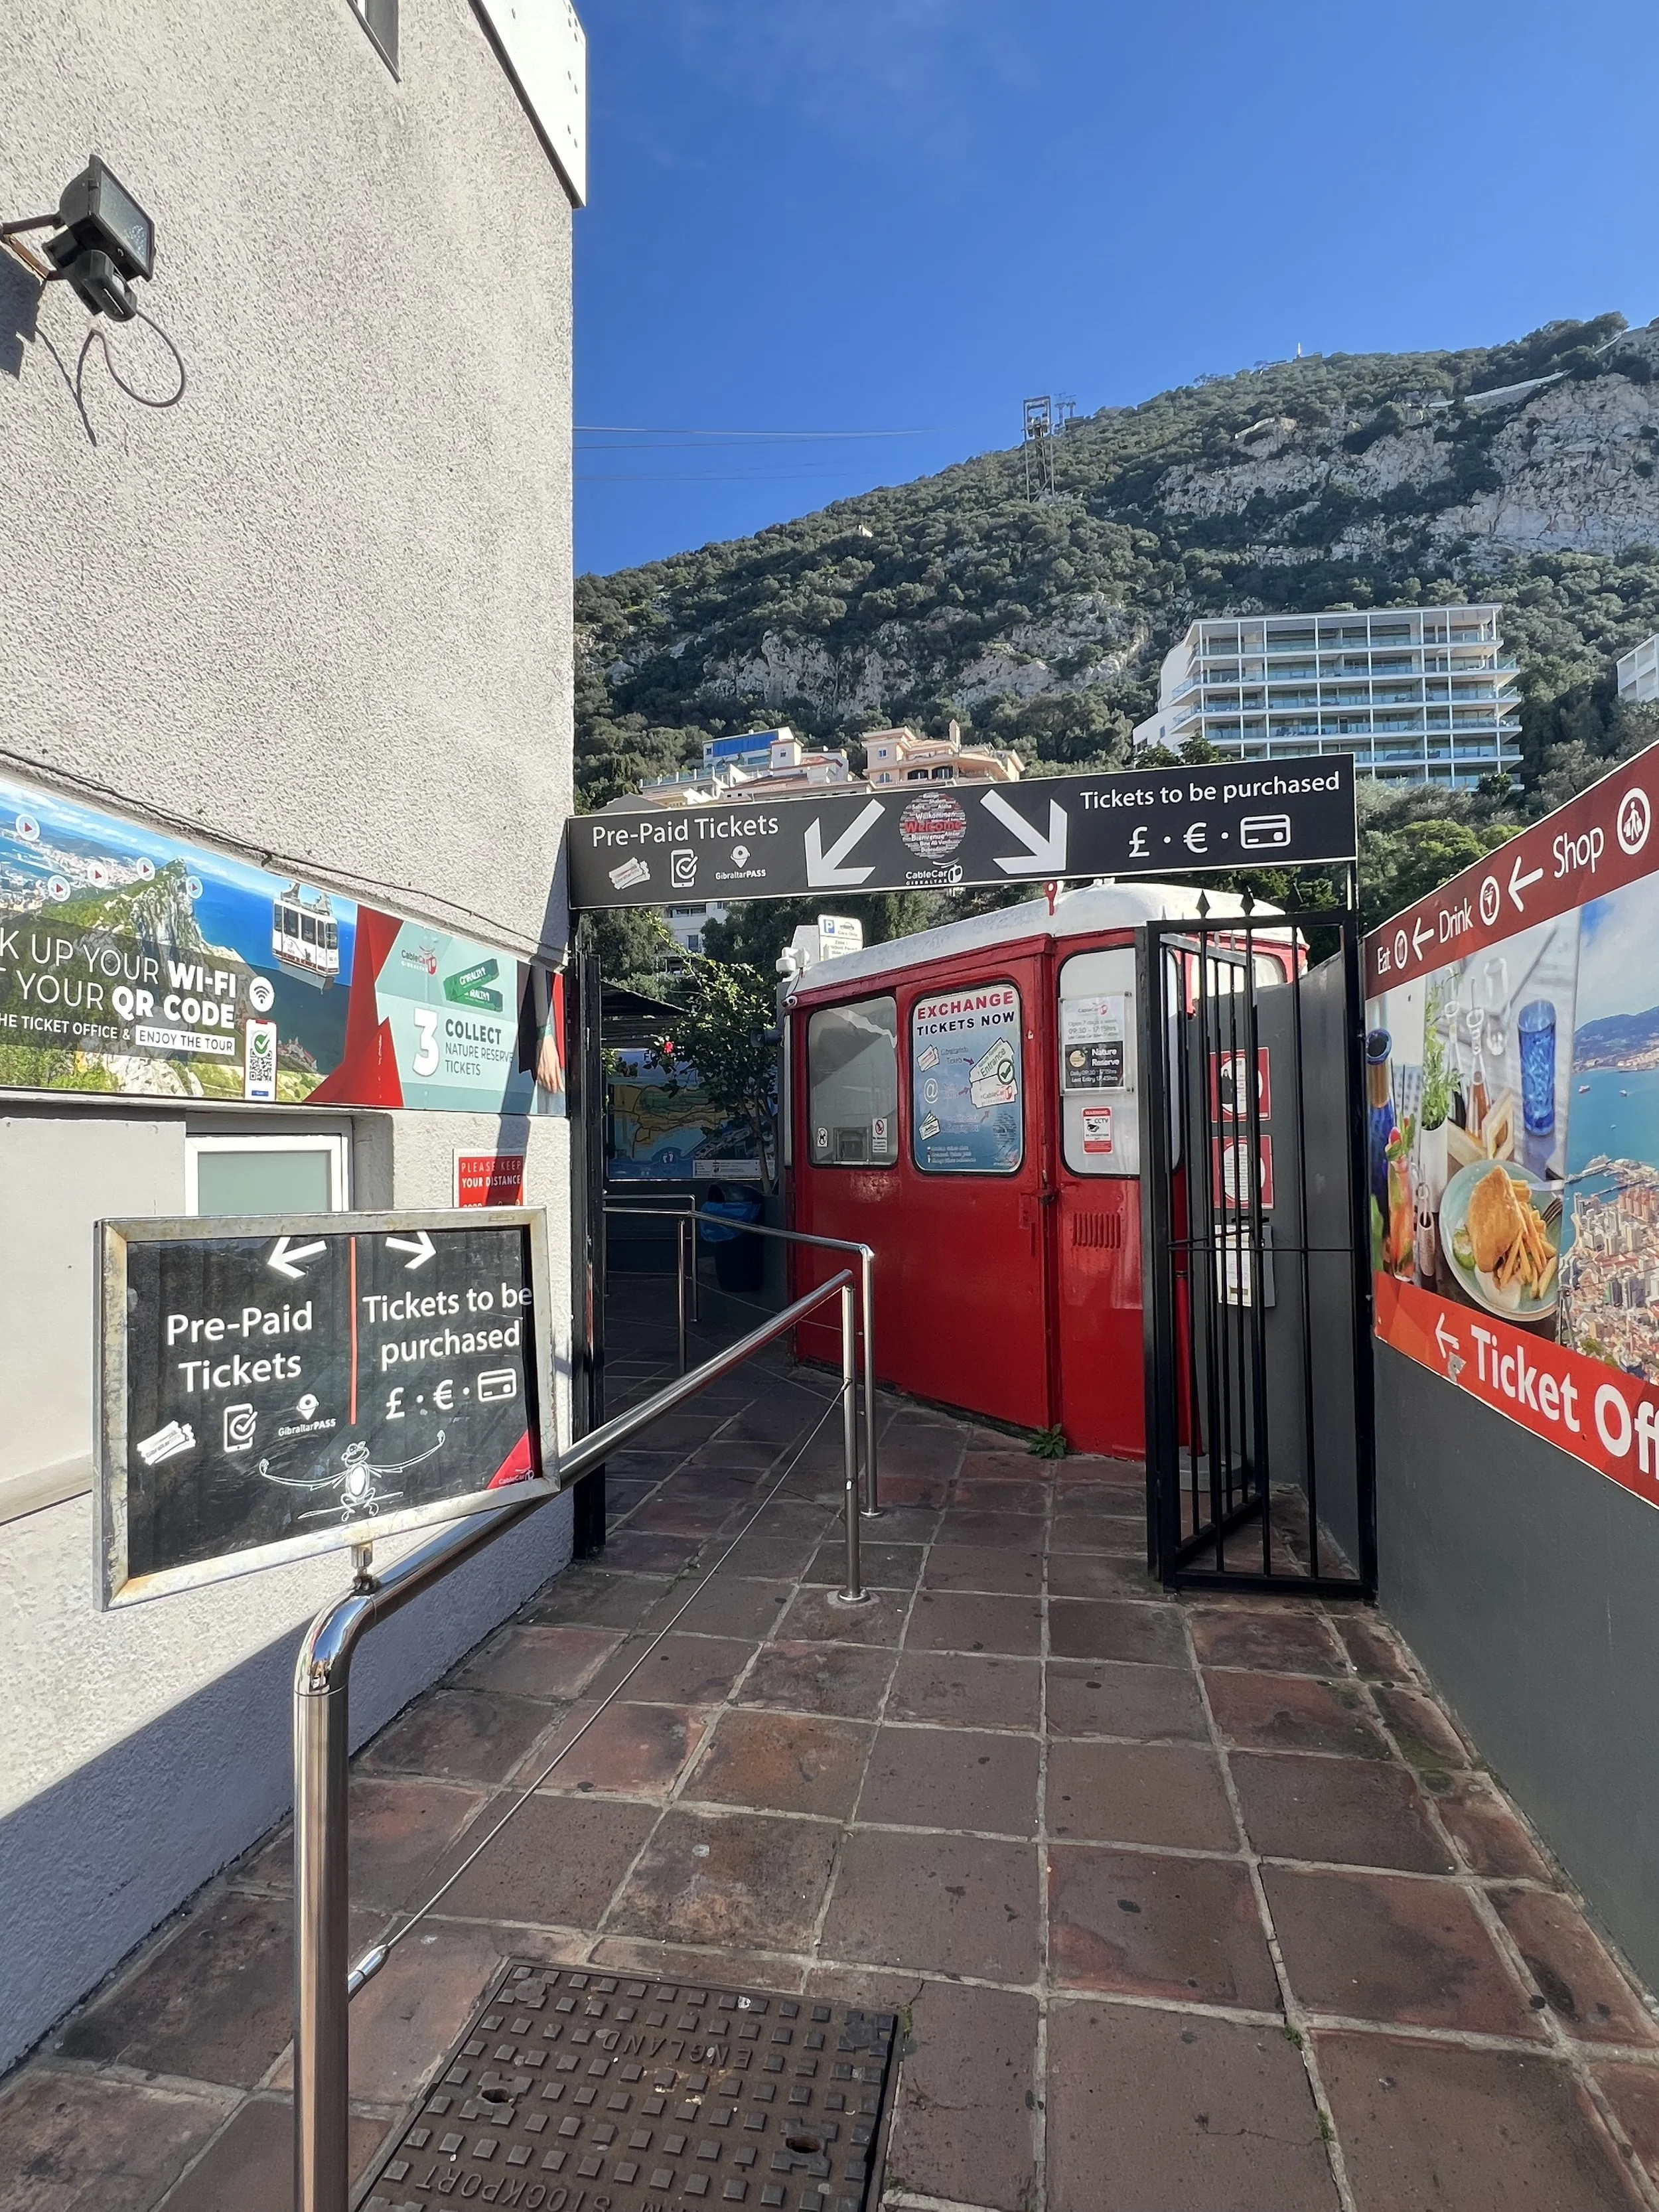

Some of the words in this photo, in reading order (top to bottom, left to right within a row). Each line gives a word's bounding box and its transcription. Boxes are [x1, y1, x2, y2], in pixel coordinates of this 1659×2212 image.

[1080, 788, 1154, 810] Tickets
[1159, 786, 1183, 804] to
[1189, 782, 1217, 802] be
[1223, 771, 1340, 804] purchased
[592, 818, 689, 848] Pre-Paid
[694, 814, 780, 840] Tickets
[904, 820, 963, 834] Welcome
[915, 812, 957, 820] Willkommen
[1128, 826, 1151, 859] £
[1183, 822, 1208, 853] €
[1552, 826, 1605, 879] Shop
[715, 868, 766, 881] GibraltarPASS
[905, 869, 948, 880] CableCar
[1438, 897, 1475, 945] Drink
[32, 933, 74, 967] UP
[82, 944, 159, 985] YOUR
[167, 960, 236, 999] WI-FI
[1376, 946, 1391, 976] Eat
[16, 970, 104, 1011] YOUR
[111, 986, 155, 1021] QR
[163, 994, 236, 1029] CODE
[917, 991, 1014, 1020] EXCHANGE
[21, 1015, 70, 1035] TICKET
[72, 1021, 118, 1040] OFFICE
[122, 1031, 131, 1041] &
[139, 1032, 178, 1046] ENJOY
[180, 1035, 202, 1049] THE
[204, 1038, 233, 1052] TOUR
[445, 1019, 502, 1045] COLLECT
[917, 1017, 975, 1036] TICKETS
[981, 1011, 1015, 1027] NOW
[412, 1006, 439, 1076] 3
[445, 1042, 479, 1059] NATURE
[481, 1047, 514, 1063] RESERVE
[1092, 1048, 1118, 1057] Nature
[445, 1059, 481, 1076] TICKETS
[980, 1048, 1006, 1077] Entrance
[1092, 1058, 1120, 1067] Reserve
[461, 1161, 496, 1173] PLEASE
[501, 1160, 522, 1171] KEEP
[461, 1176, 483, 1189] YOUR
[485, 1175, 521, 1187] DISTANCE
[362, 1291, 459, 1324] Tickets
[467, 1286, 494, 1311] to
[501, 1282, 533, 1309] be
[166, 1300, 313, 1346] Pre-Paid
[381, 1319, 521, 1371] purchased
[178, 1352, 302, 1393] Tickets
[385, 1386, 405, 1420] £
[433, 1378, 455, 1411] €
[1470, 1323, 1581, 1433] Ticket
[1594, 1382, 1659, 1481] Of
[277, 1418, 336, 1437] GibraltarPASS
[602, 2029, 753, 2070] ENGLAND
